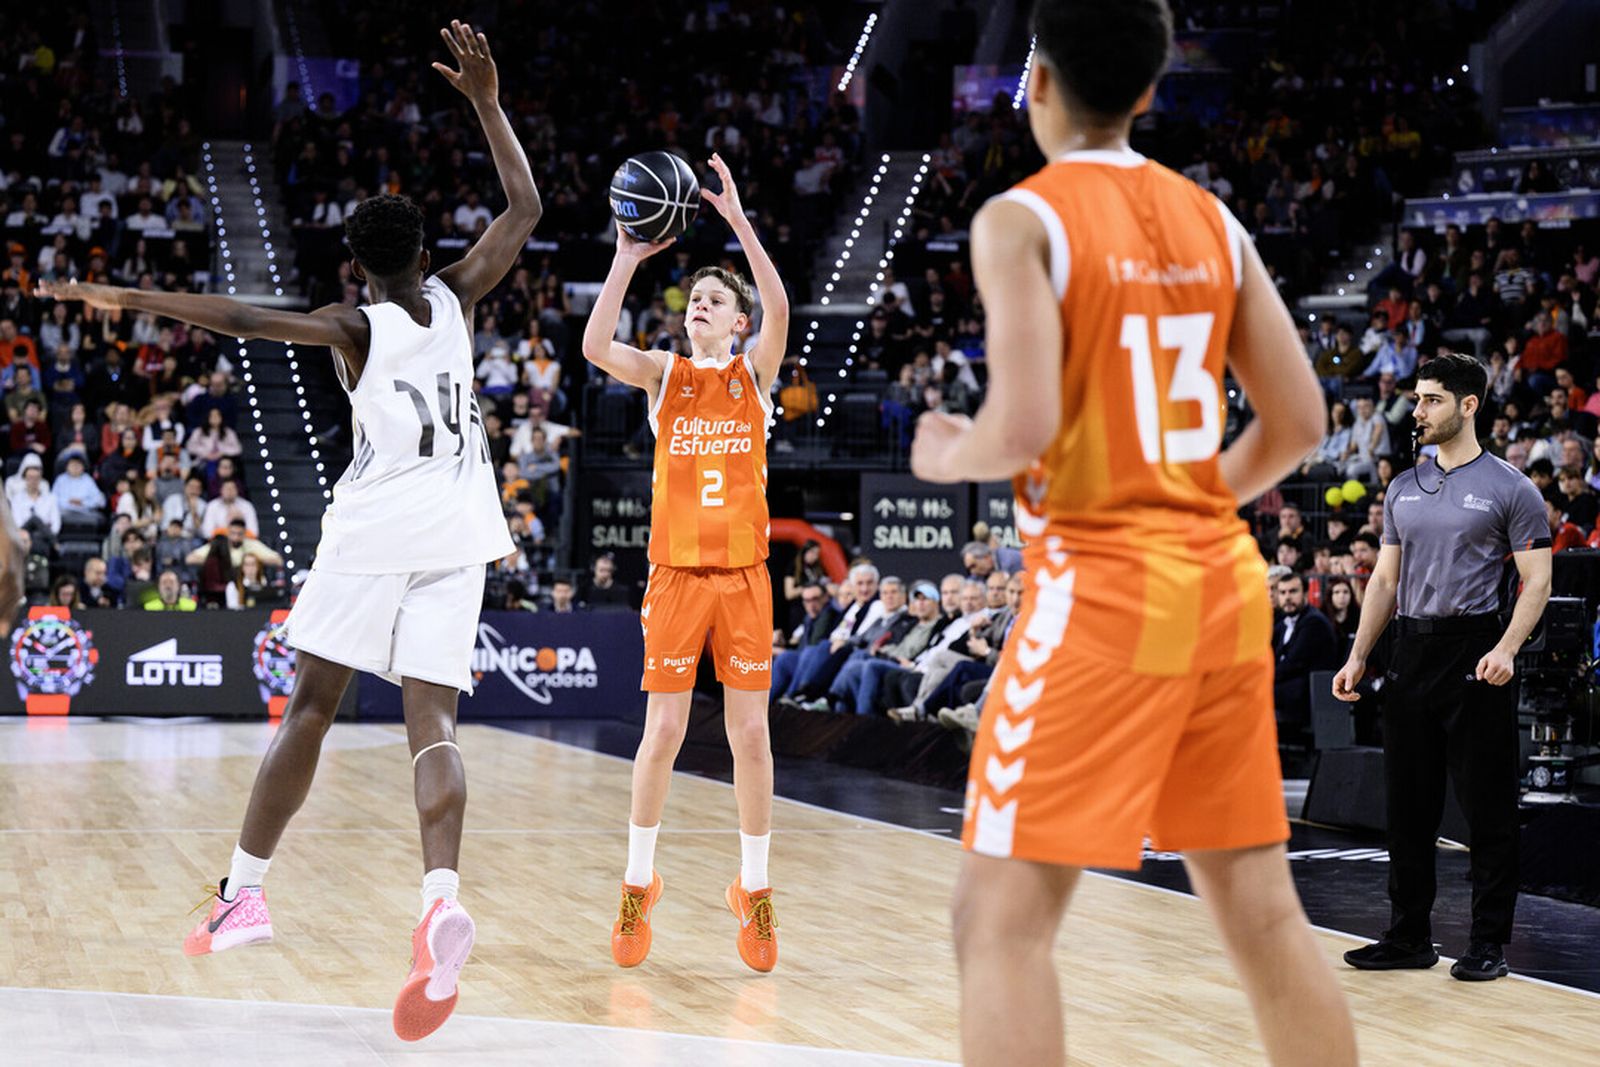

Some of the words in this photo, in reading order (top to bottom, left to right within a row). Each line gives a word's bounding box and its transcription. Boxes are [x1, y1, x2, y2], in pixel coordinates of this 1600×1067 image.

[1120, 312, 1220, 464] 13
[394, 372, 465, 457] 14
[672, 416, 735, 435] Cultura
[736, 422, 752, 433] del
[669, 436, 752, 455] Esfuerzo
[701, 469, 725, 507] 2
[592, 525, 650, 548] SALID
[873, 525, 954, 549] SALIDA
[126, 662, 223, 686] LOTUS
[525, 673, 598, 688] endesa
